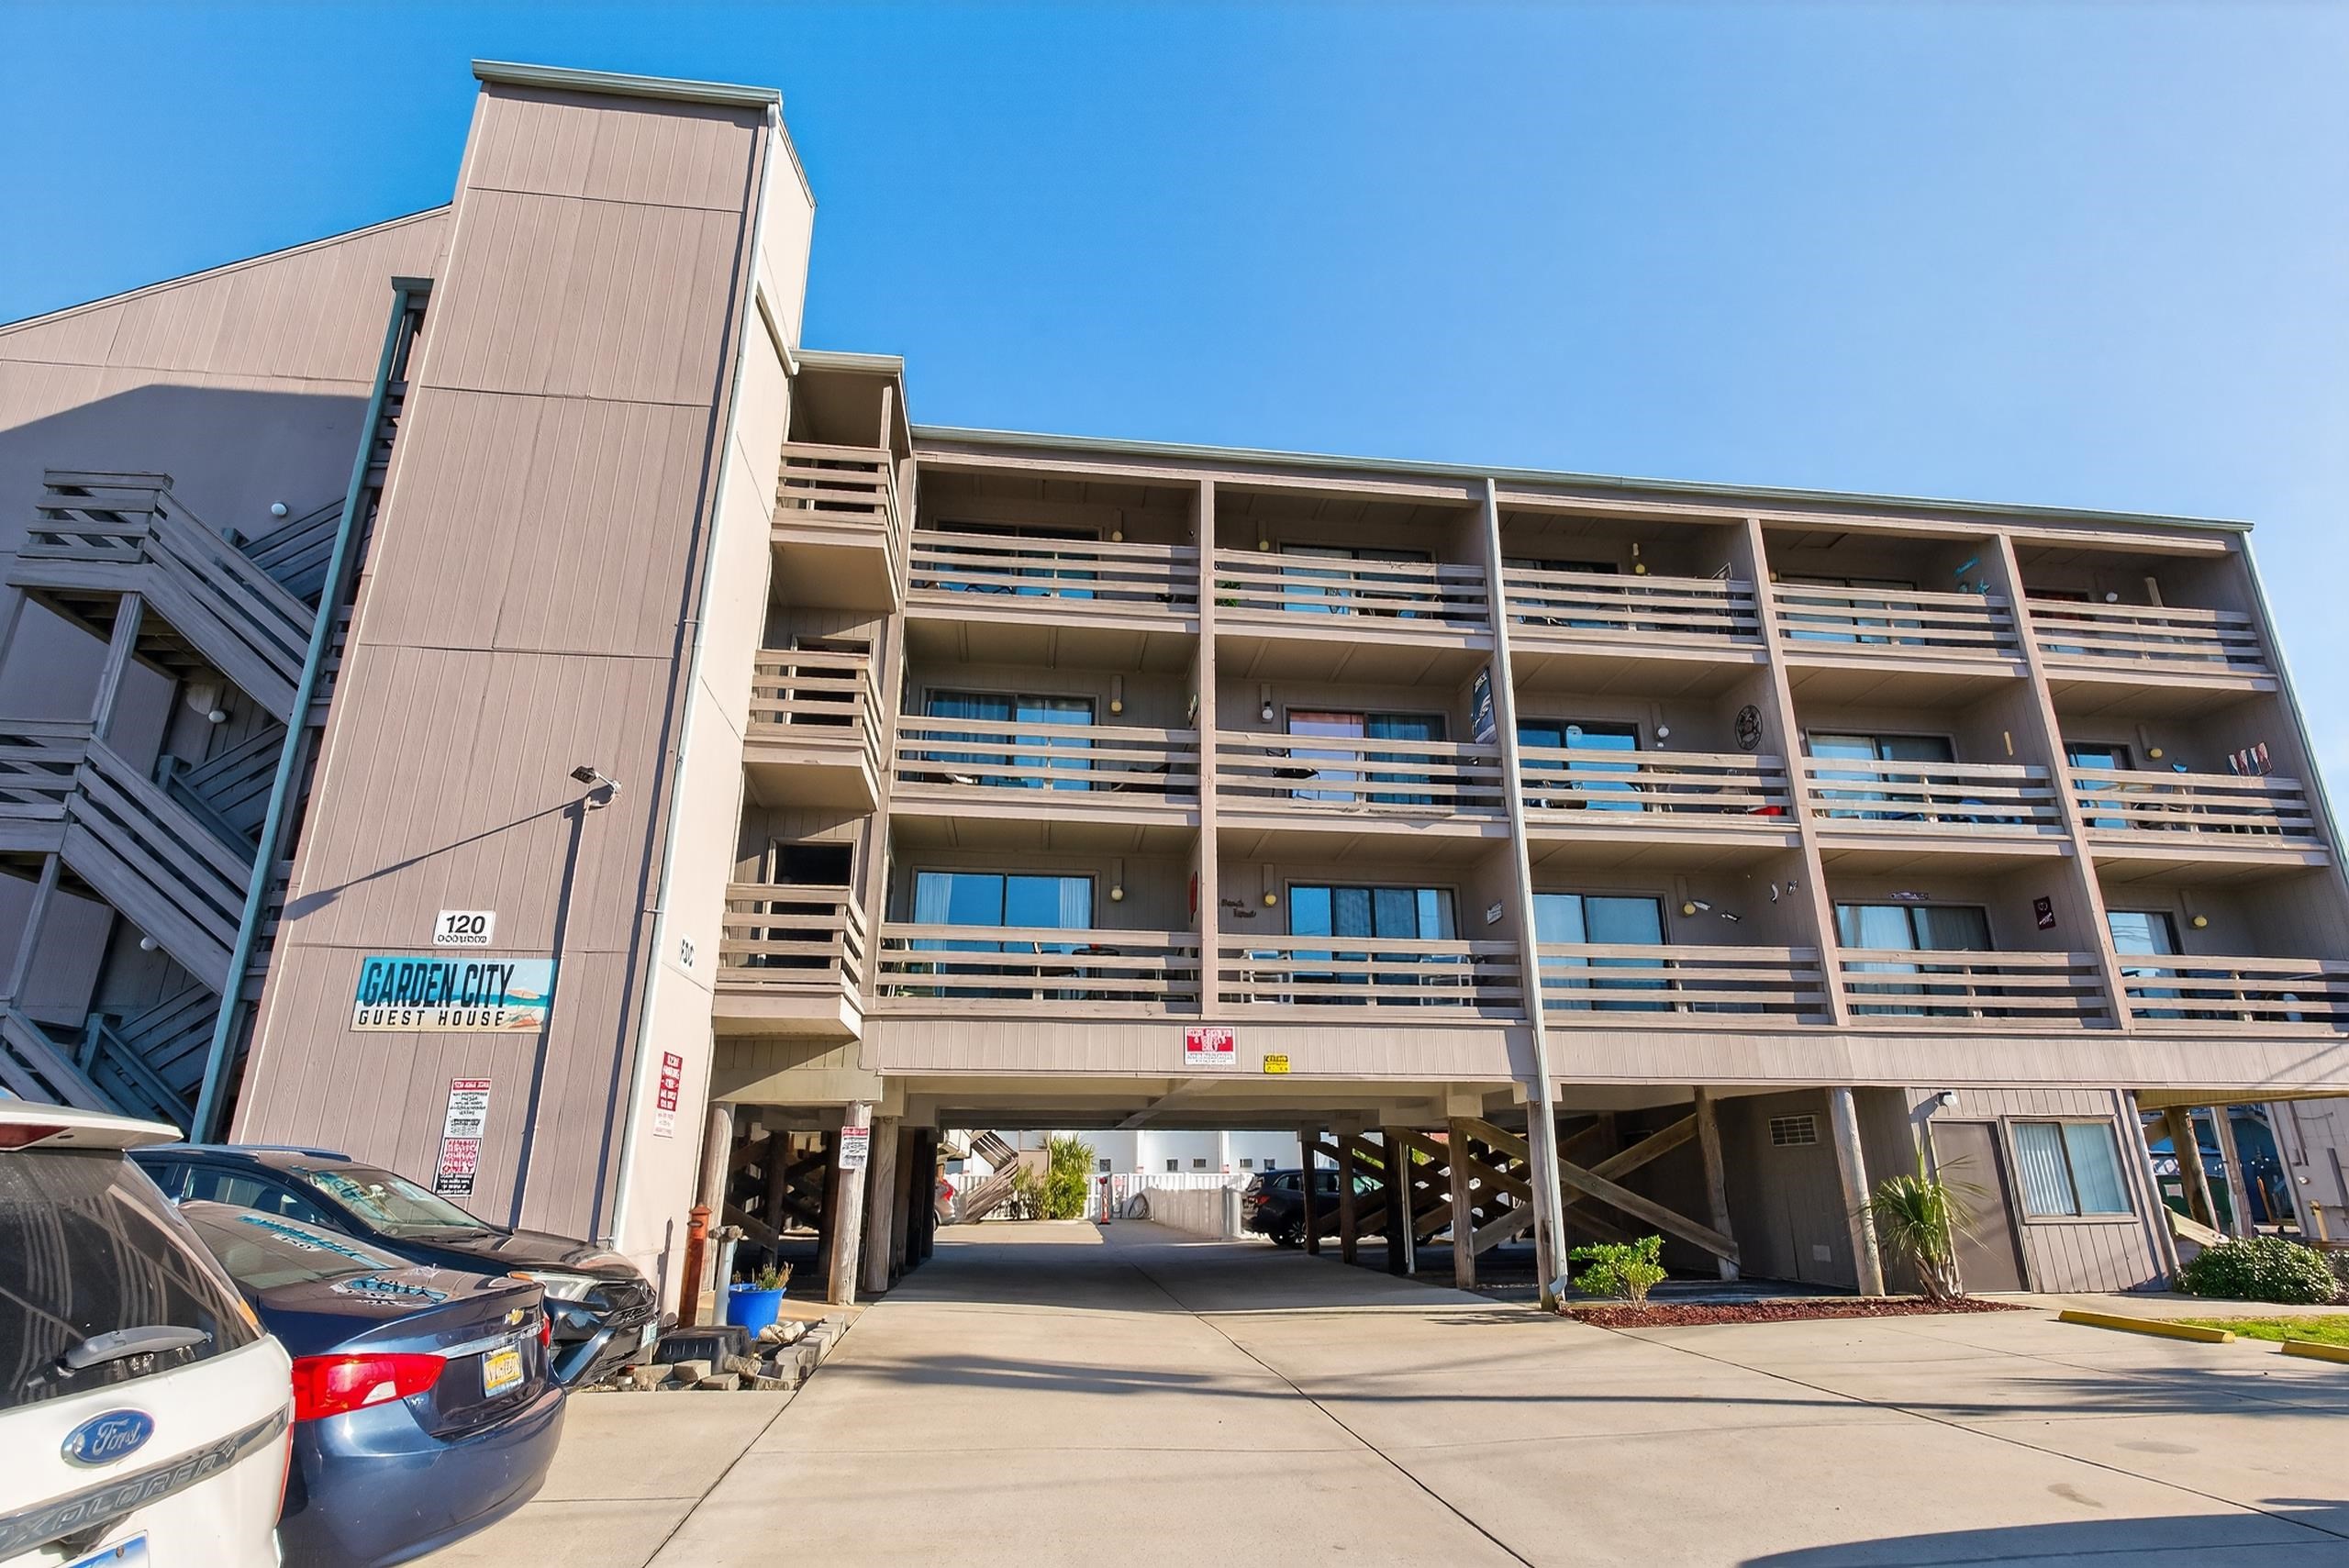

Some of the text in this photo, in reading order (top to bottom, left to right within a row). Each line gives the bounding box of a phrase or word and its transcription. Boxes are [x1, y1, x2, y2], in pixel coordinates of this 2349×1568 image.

[446, 915, 486, 935] 120
[362, 962, 515, 1008] GARDEN CITY
[358, 1009, 506, 1027] GUEST HOUSE
[92, 1418, 143, 1456] Ford
